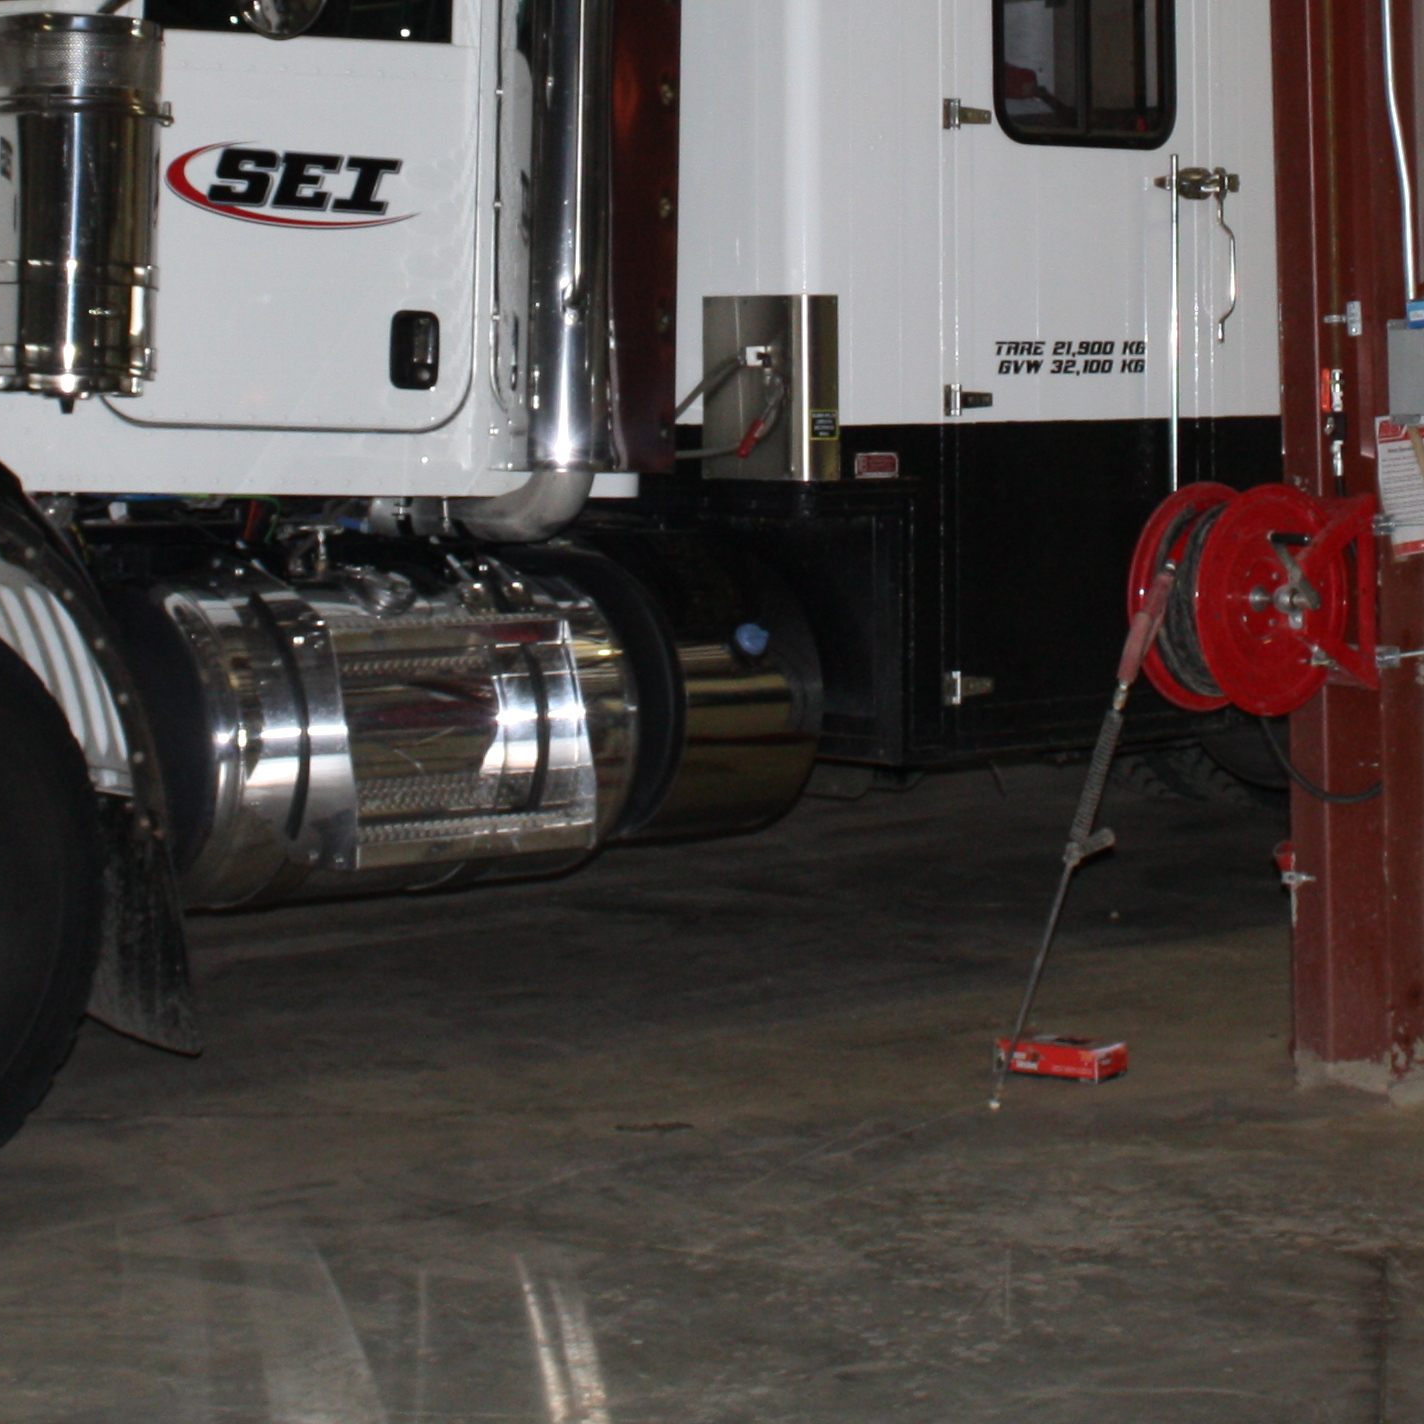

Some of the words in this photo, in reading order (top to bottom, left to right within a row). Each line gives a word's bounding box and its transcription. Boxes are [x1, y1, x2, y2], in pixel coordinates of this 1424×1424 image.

[207, 147, 403, 215] SEI
[995, 341, 1046, 356] TARE
[1052, 341, 1115, 358] 21,900
[1122, 341, 1146, 356] KG
[998, 359, 1044, 375] GVW
[1050, 359, 1114, 376] 32,100
[1120, 359, 1145, 374] KG
